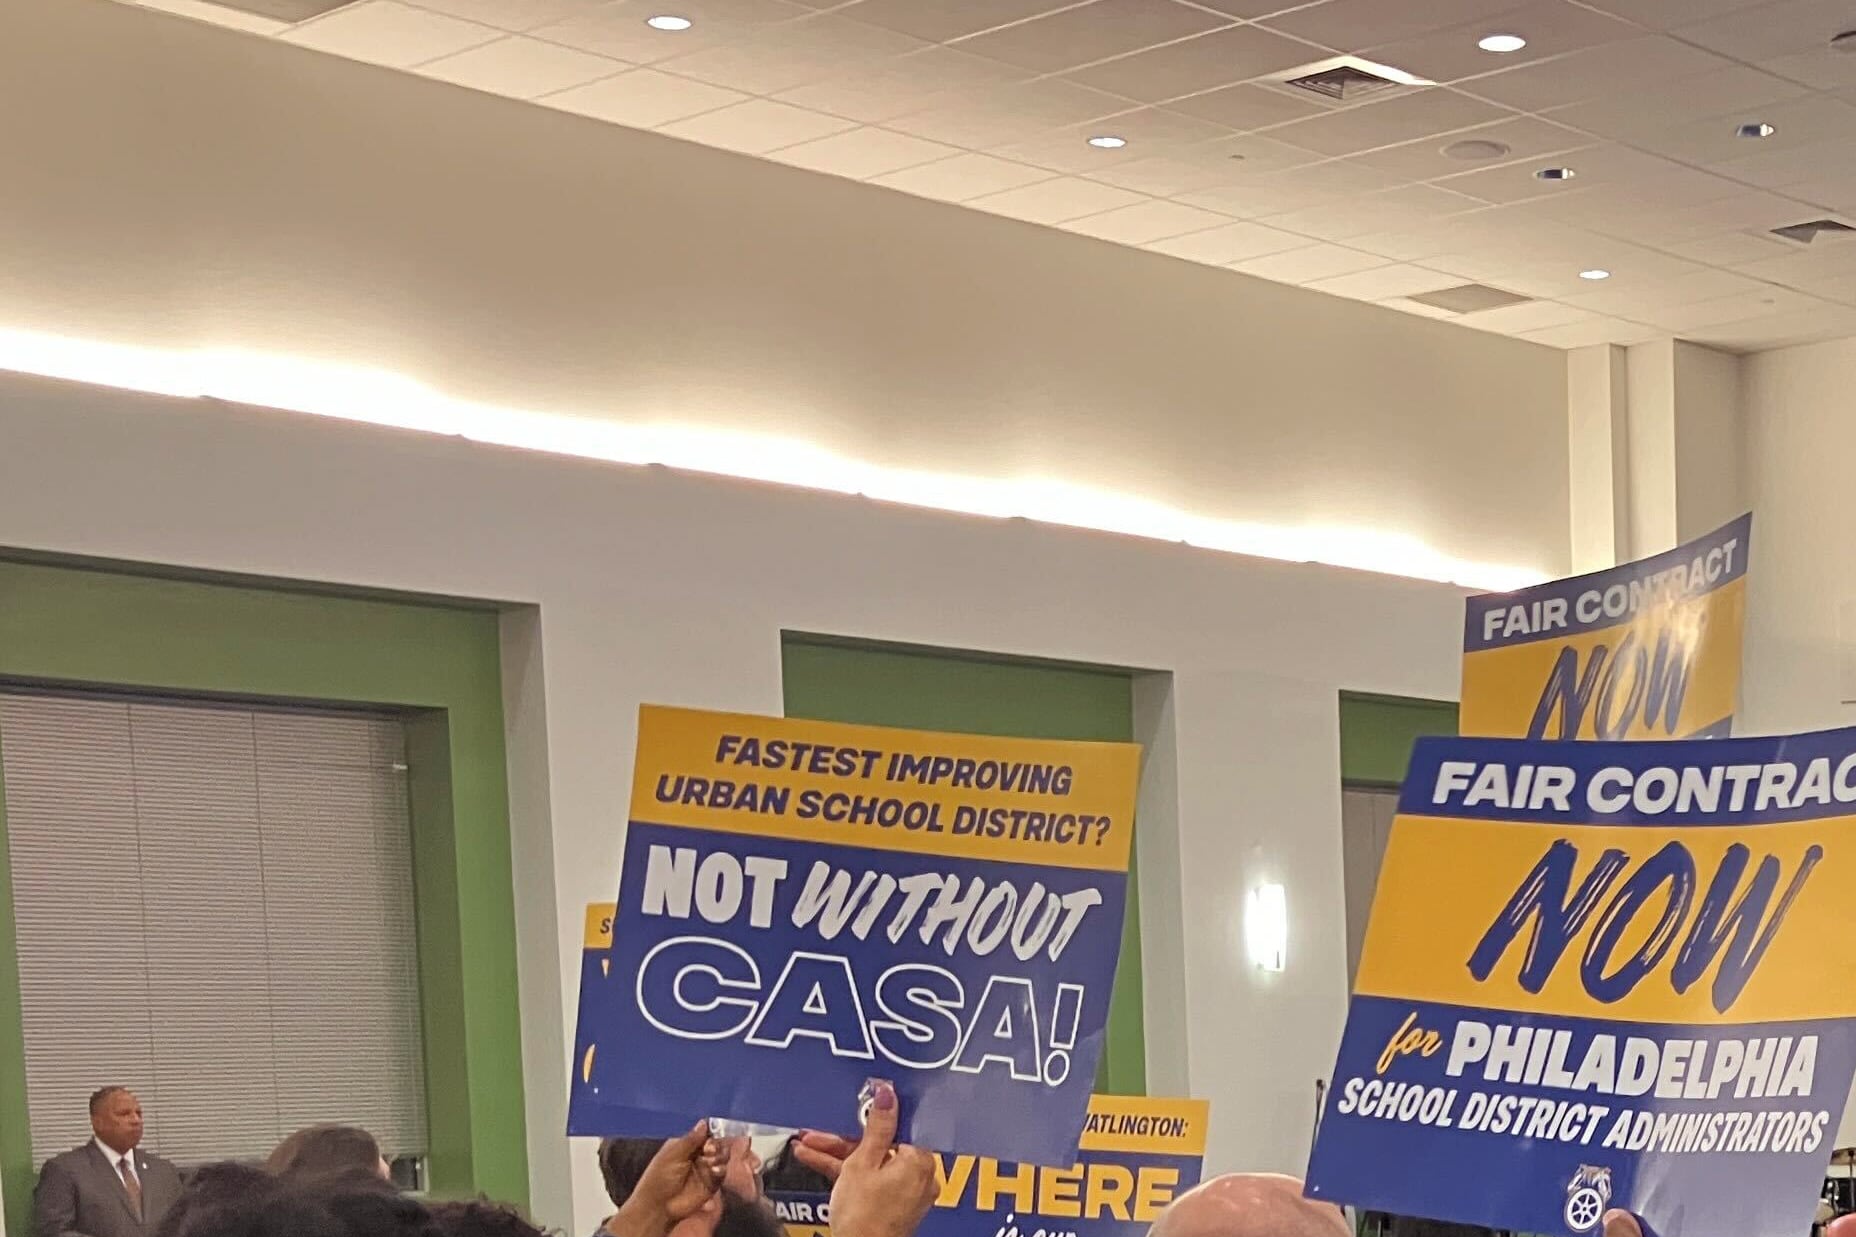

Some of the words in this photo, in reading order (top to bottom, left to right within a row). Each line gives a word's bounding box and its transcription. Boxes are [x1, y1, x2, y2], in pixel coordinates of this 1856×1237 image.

[1483, 598, 1568, 641] FAIR
[1575, 538, 1737, 624] CONTRACT
[1526, 618, 1700, 741] NOW
[715, 734, 882, 780] FASTEST
[885, 752, 1073, 796] IMPROVING
[1432, 761, 1574, 811] FAIR
[655, 773, 790, 816] URBAN
[796, 789, 944, 834] SCHOOL
[951, 806, 1111, 847] DISTRICT?
[641, 844, 787, 928] NOT
[791, 860, 1102, 962] WITHOUT
[1467, 838, 1824, 1015] NOW
[635, 935, 1084, 1087] CASA!
[1376, 1011, 1443, 1074] for
[1445, 1020, 1819, 1100] PHILADELPHIA
[1084, 1113, 1189, 1138] ATLINGTON:
[1338, 1077, 1453, 1128] SCHOOL
[1458, 1094, 1604, 1146] DISTRICT
[1603, 1106, 1830, 1154] ADMINISTRATORS
[776, 1201, 813, 1222] AIR
